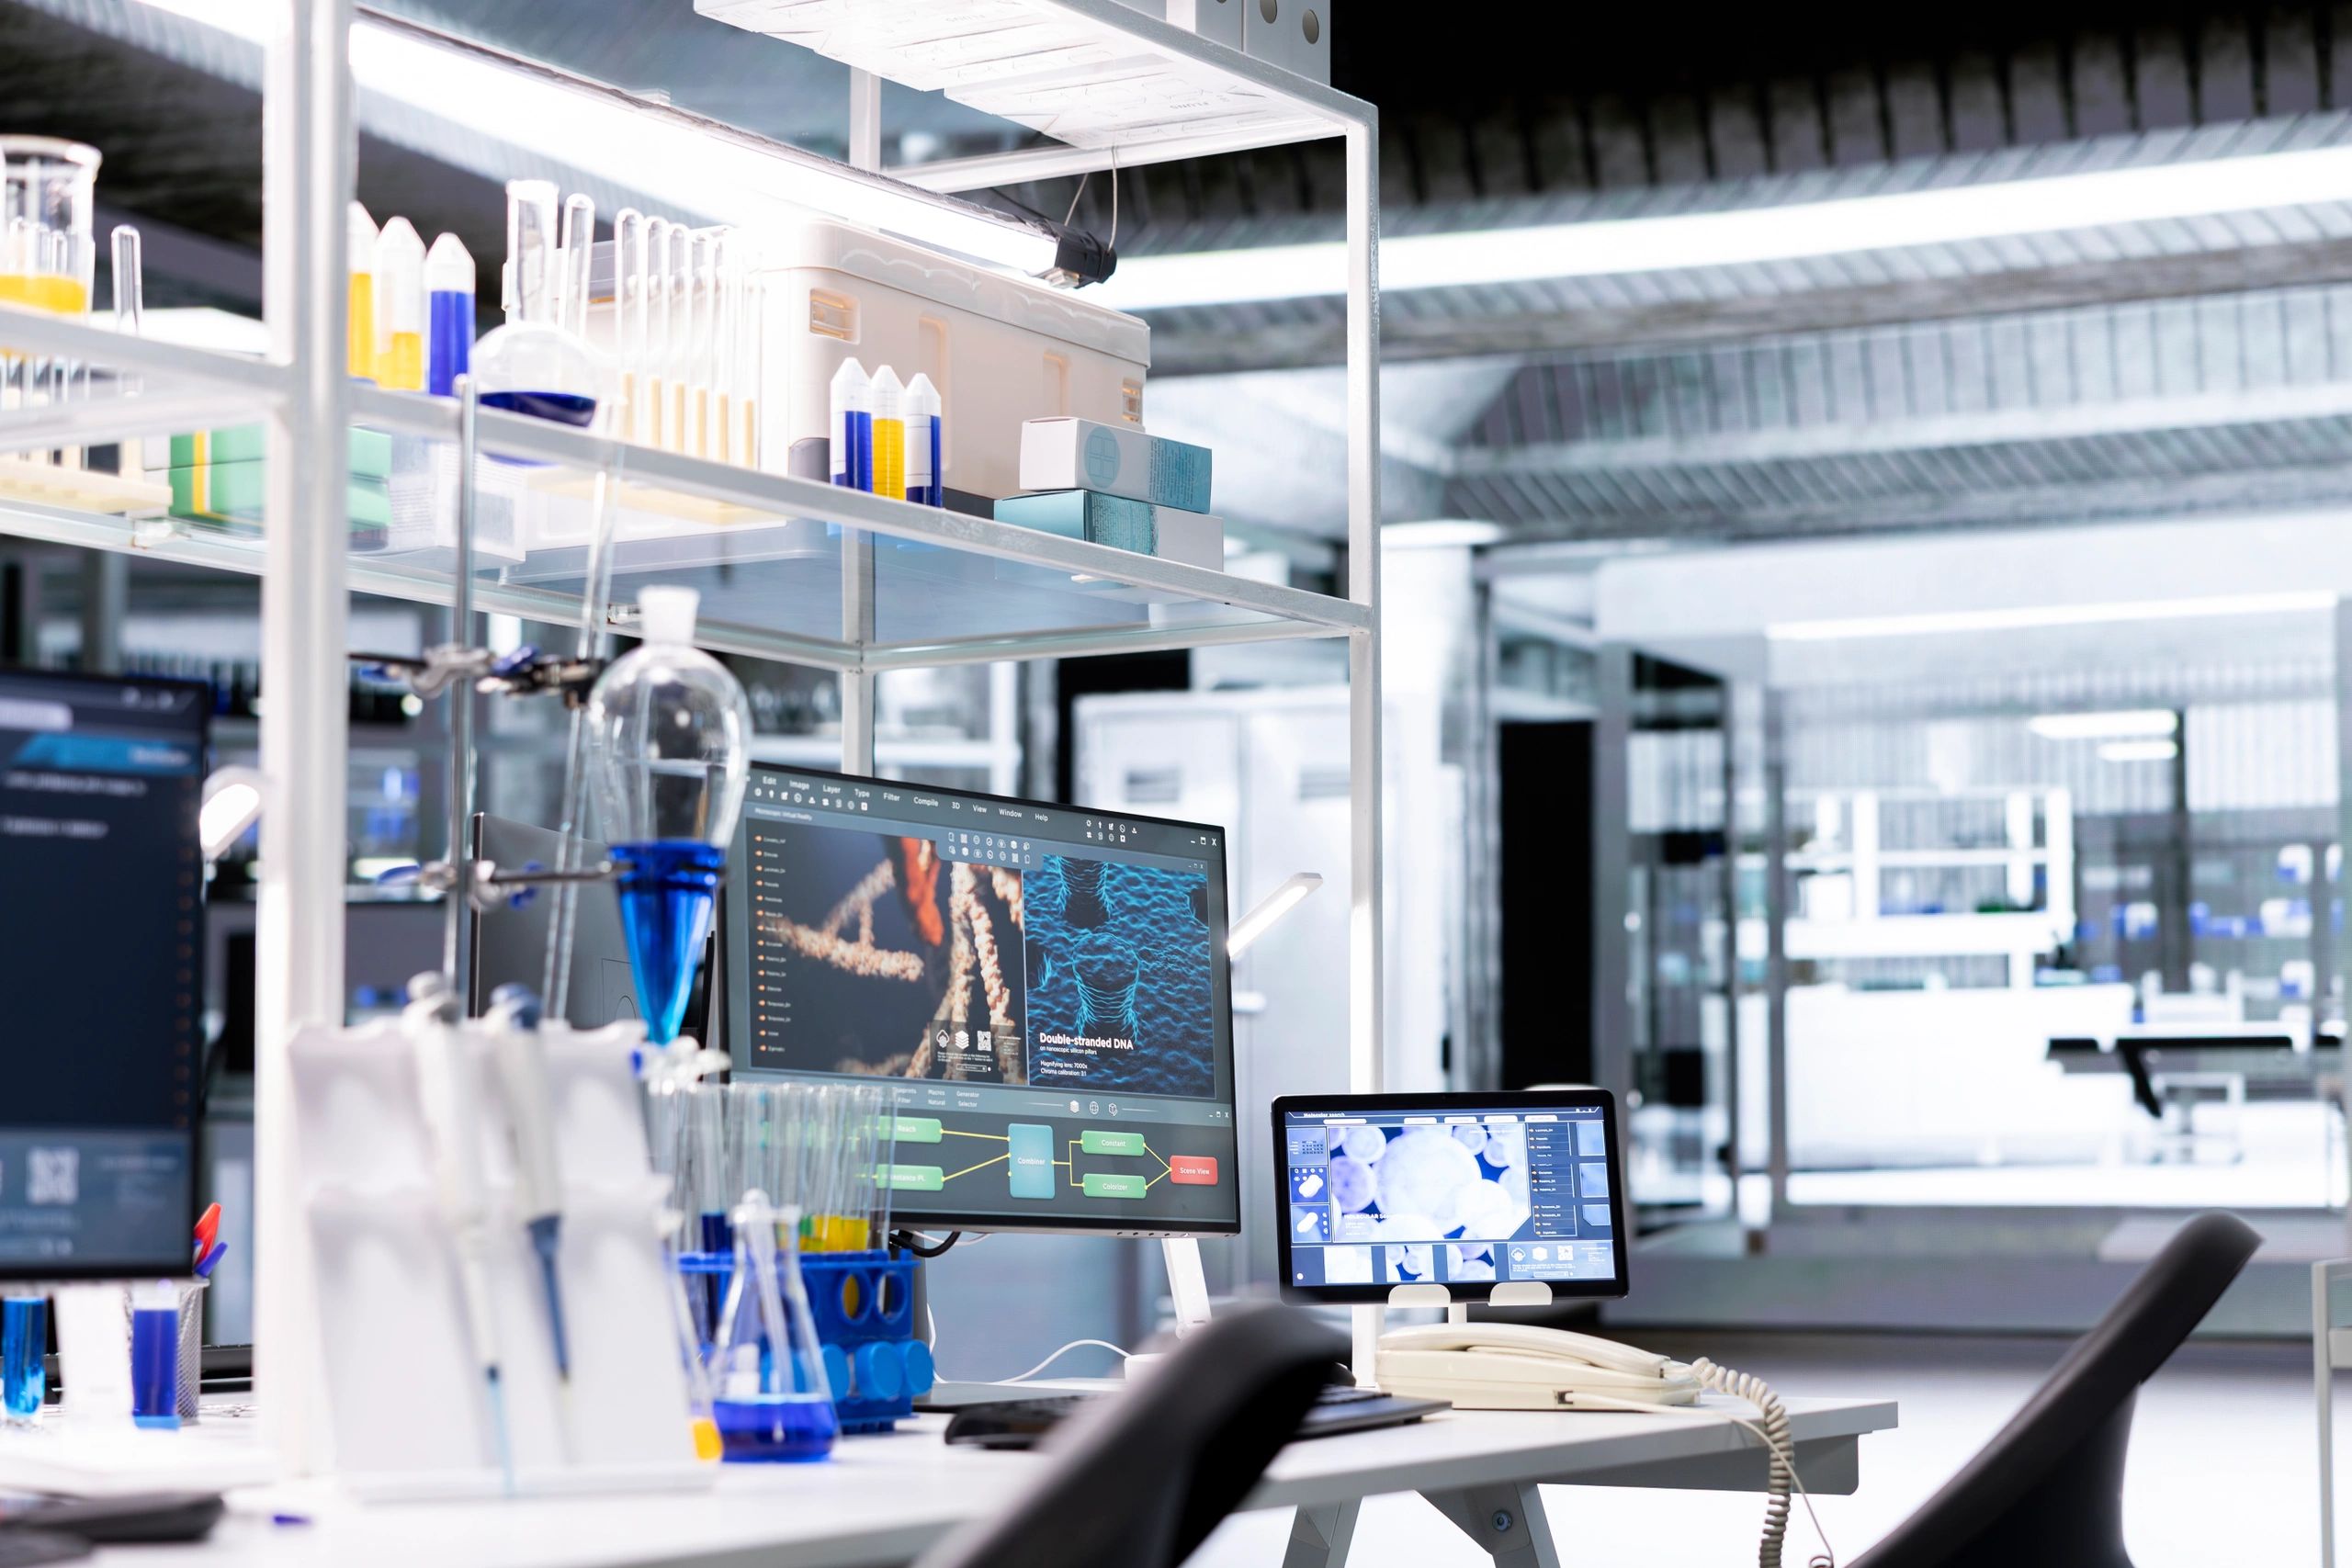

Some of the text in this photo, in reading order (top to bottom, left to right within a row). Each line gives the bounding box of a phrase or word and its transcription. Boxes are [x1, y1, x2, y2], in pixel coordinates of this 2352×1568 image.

[763, 776, 1049, 822] Edit Image Layer Type Filter Compile 3D View Window Help
[1039, 1032, 1135, 1050] Double-stranded DNA
[1101, 1139, 1126, 1147] Constant
[1017, 1156, 1046, 1166] Combiner
[1180, 1167, 1210, 1176] Scene View
[1102, 1182, 1128, 1191] Colorizer
